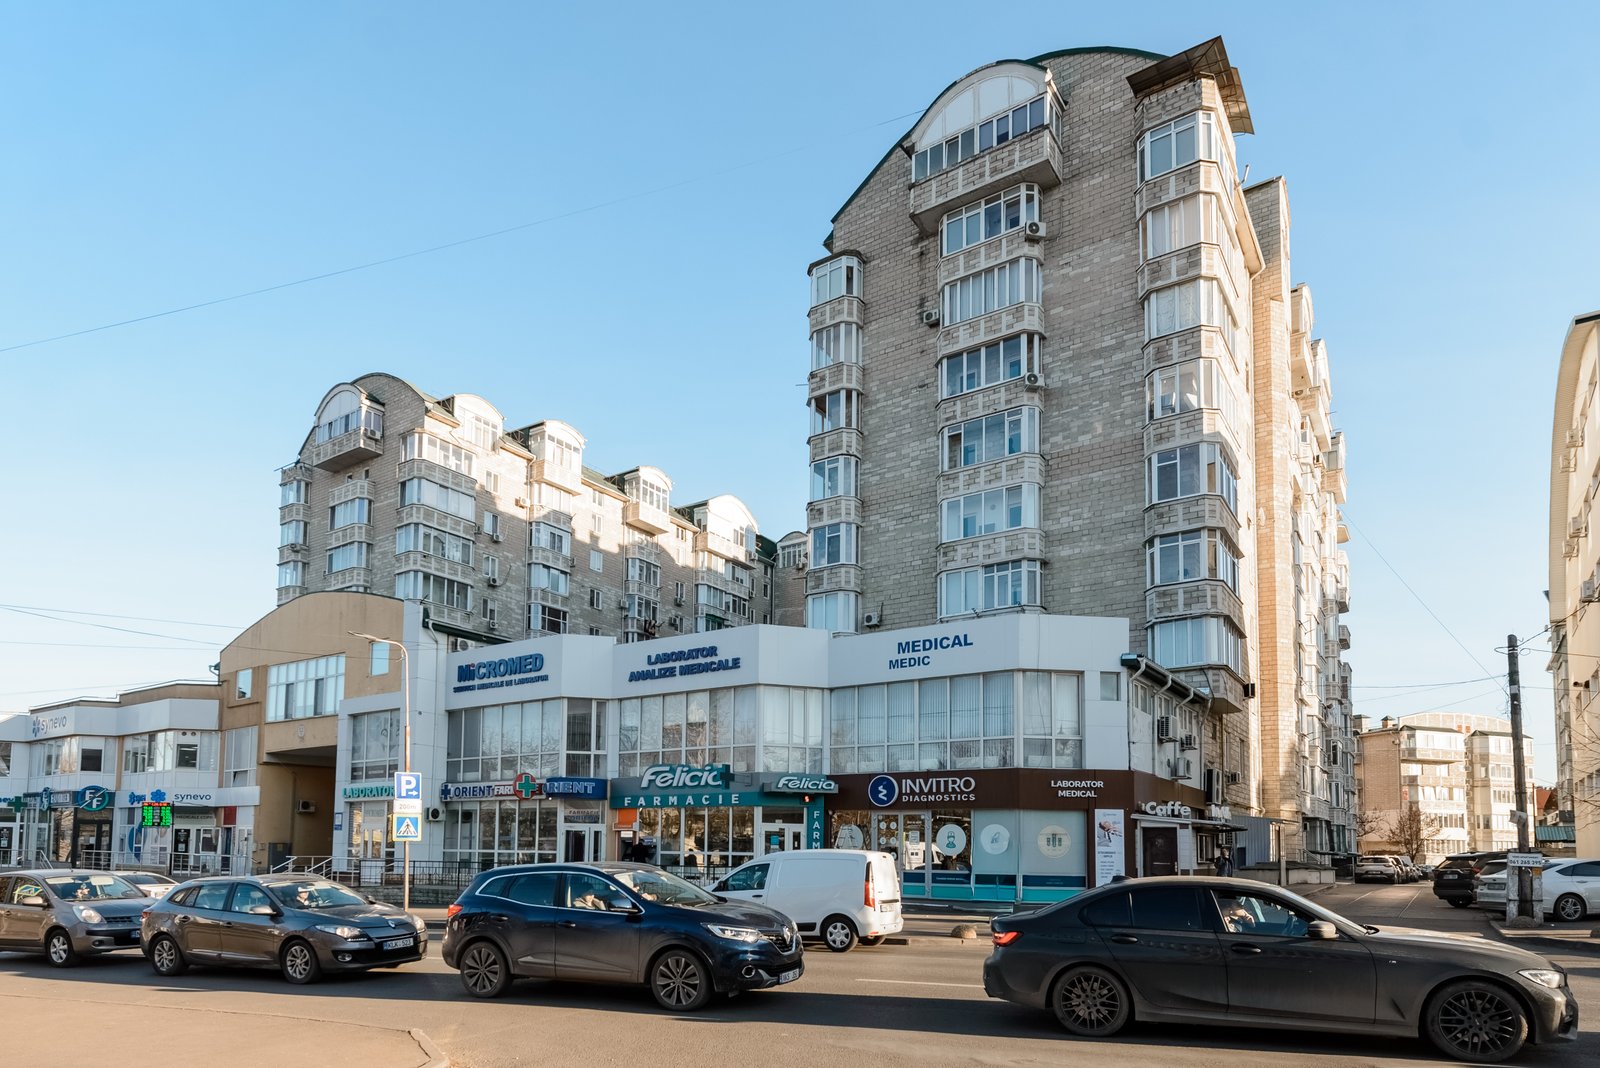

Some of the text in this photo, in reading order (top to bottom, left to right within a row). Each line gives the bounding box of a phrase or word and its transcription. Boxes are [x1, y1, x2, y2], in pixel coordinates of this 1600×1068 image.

[897, 634, 973, 654] MEDICAL
[647, 645, 718, 665] LABORATOR
[889, 655, 930, 669] MEDIC
[628, 657, 741, 682] ANALIZE MEDICALE
[41, 715, 67, 735] synevo
[401, 775, 417, 797] P
[777, 776, 836, 790] Felicia
[902, 777, 976, 793] INVITRO
[1051, 780, 1104, 788] LABORATOR
[174, 793, 212, 802] synevo
[342, 785, 395, 798] LABORATOR
[453, 785, 494, 797] ORIENT
[902, 794, 976, 802] DIAGNOSTICS
[1058, 790, 1098, 798] MEDICAL
[624, 794, 740, 806] FARMACIE
[1145, 801, 1191, 816] Caffe
